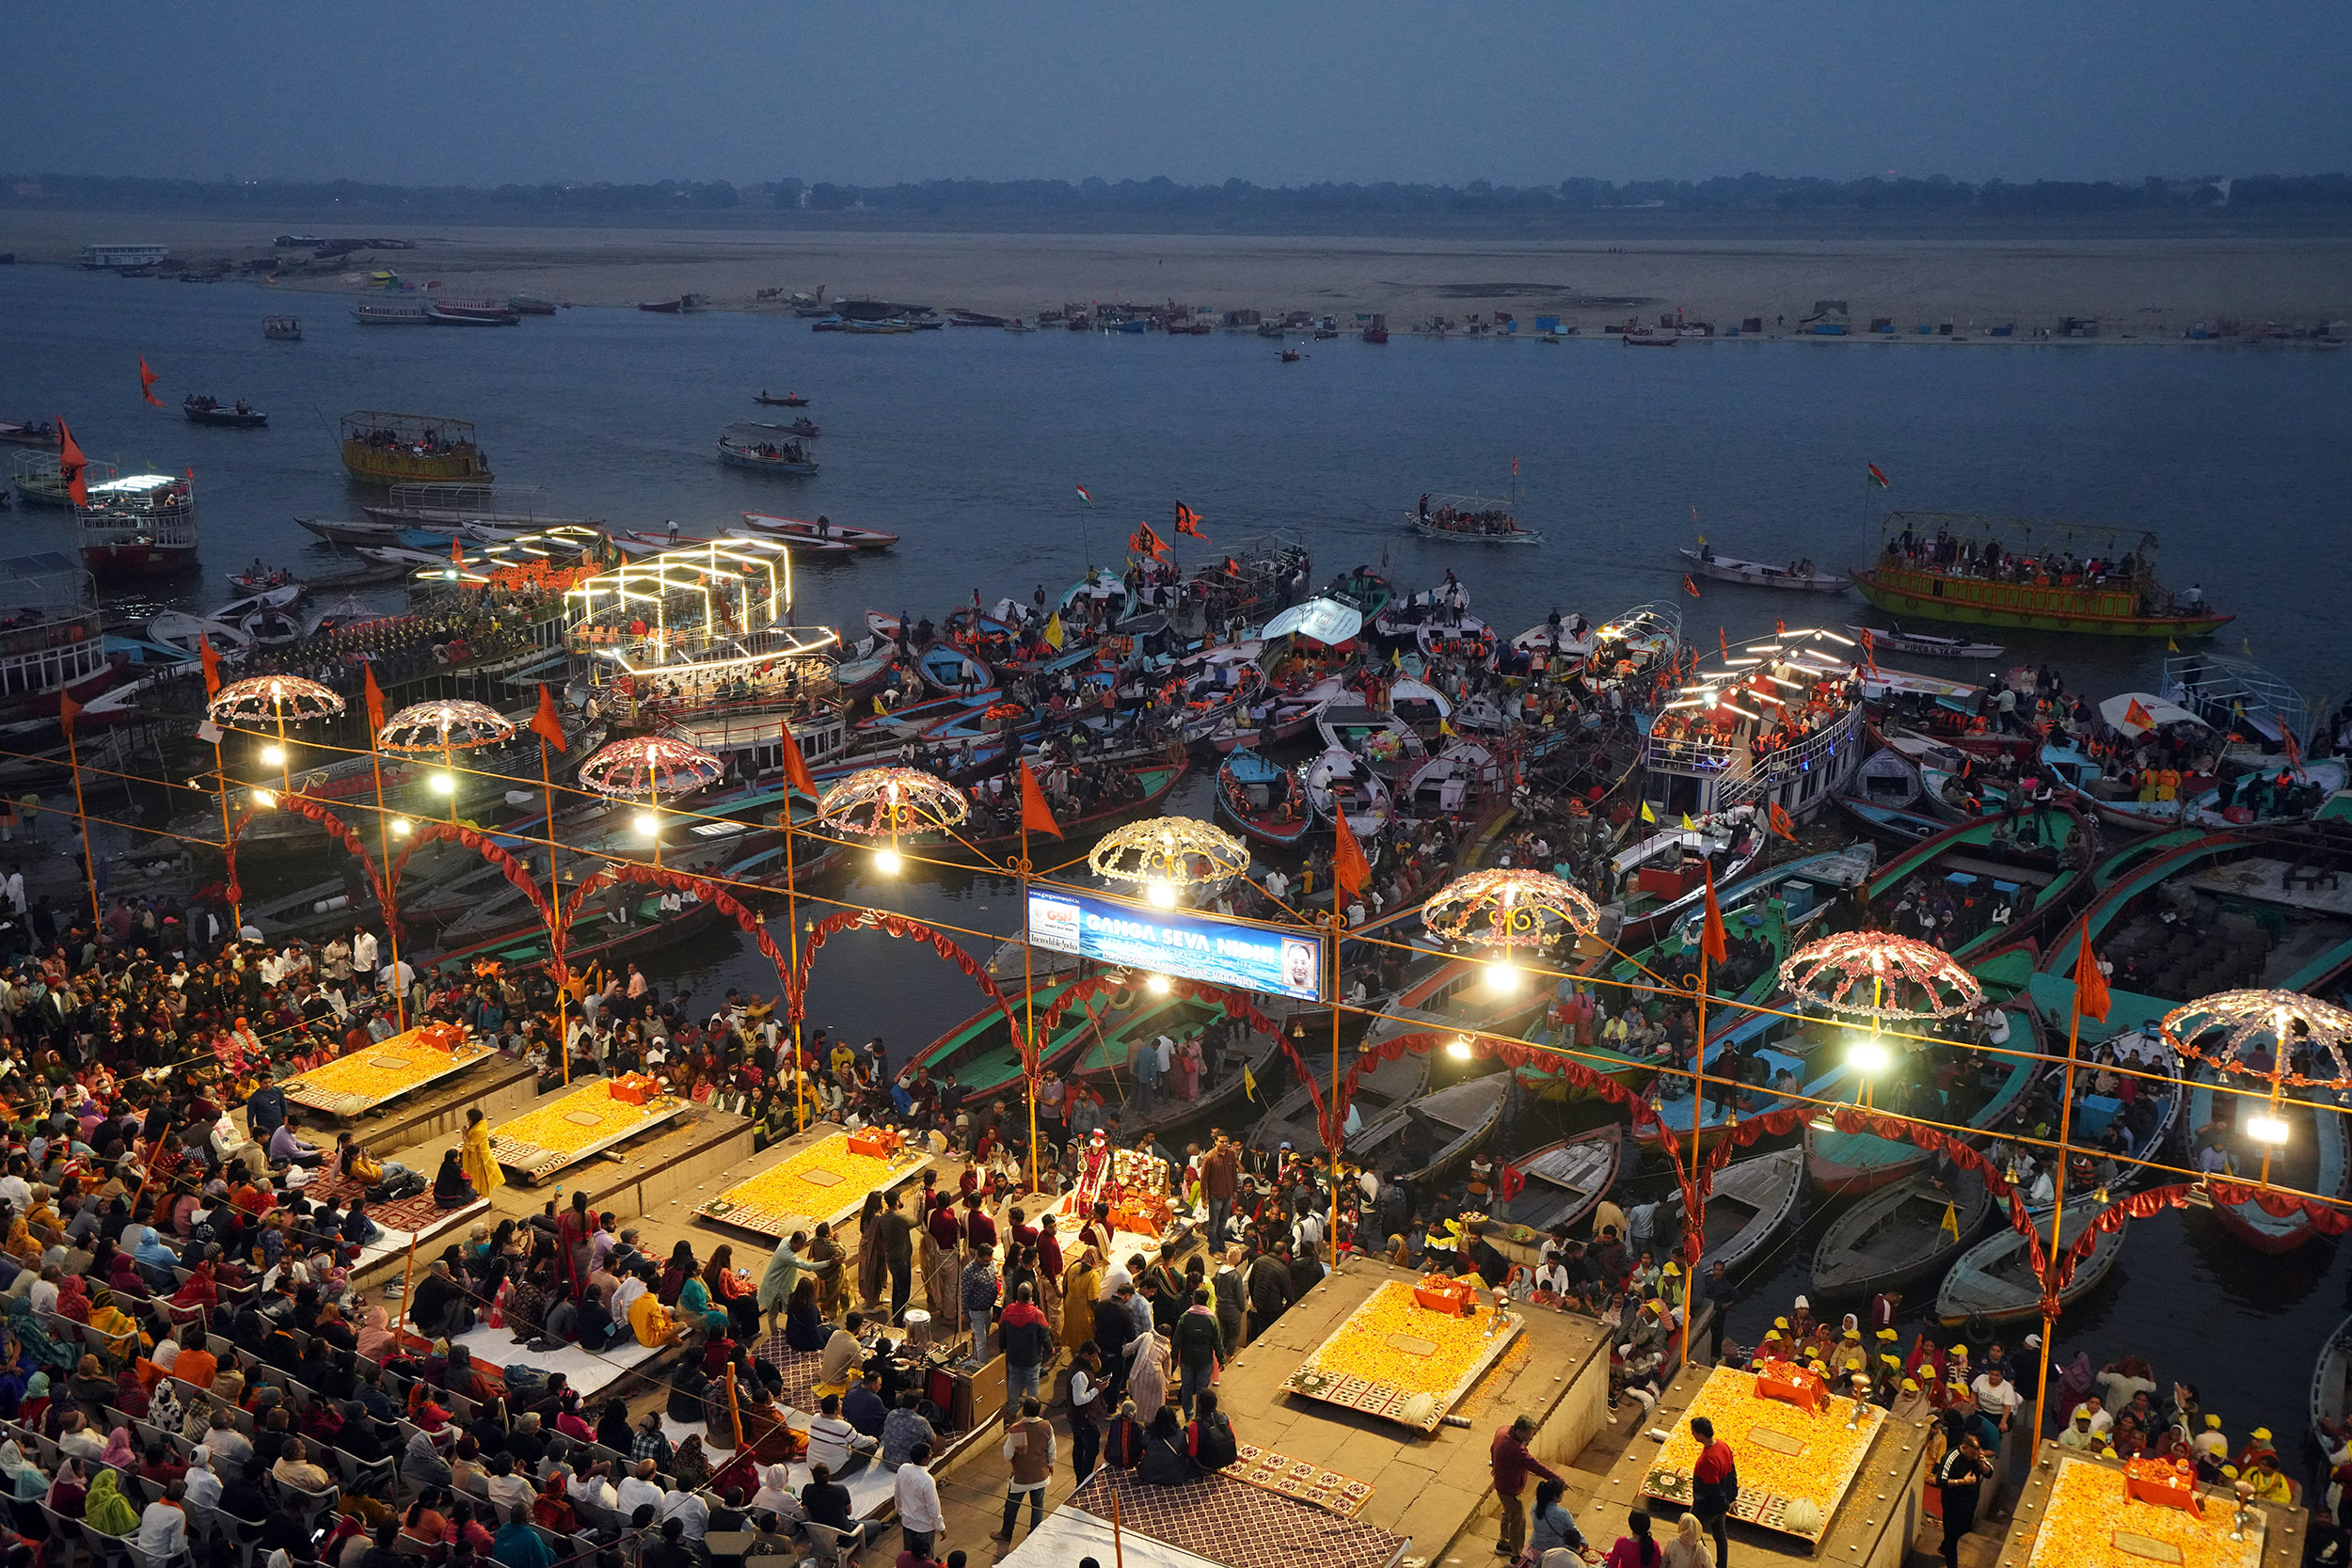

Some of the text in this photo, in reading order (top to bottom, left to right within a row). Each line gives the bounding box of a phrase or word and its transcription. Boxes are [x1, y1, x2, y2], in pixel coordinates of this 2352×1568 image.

[1904, 643, 1929, 653] PIPES
[1086, 913, 1157, 942] GANGA
[1162, 927, 1211, 953] SEVA
[1216, 938, 1276, 965] NIDHI
